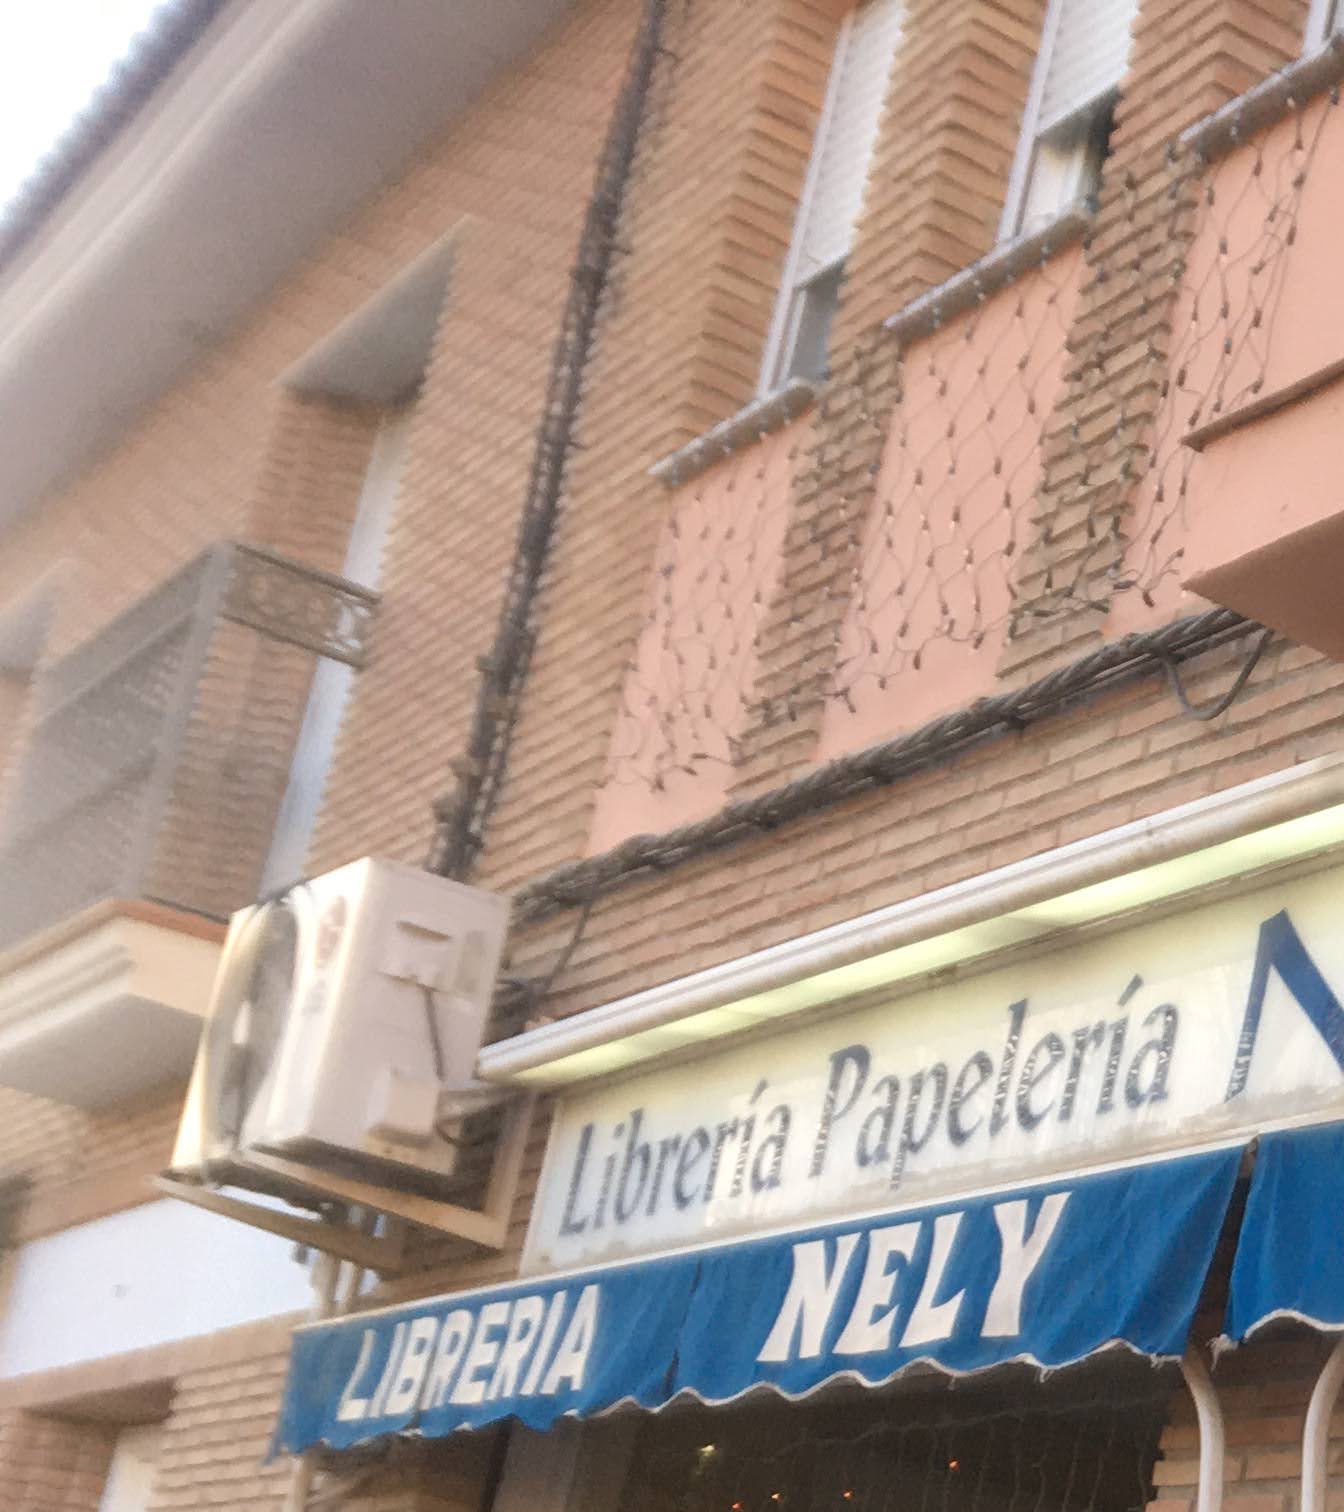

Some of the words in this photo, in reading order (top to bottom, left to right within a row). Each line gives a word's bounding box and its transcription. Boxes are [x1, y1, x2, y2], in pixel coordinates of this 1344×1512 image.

[562, 1080, 793, 1238] Librería
[805, 975, 1177, 1187] Papelería
[337, 1283, 603, 1422] LIBRERIA
[757, 1191, 1075, 1364] NELY
